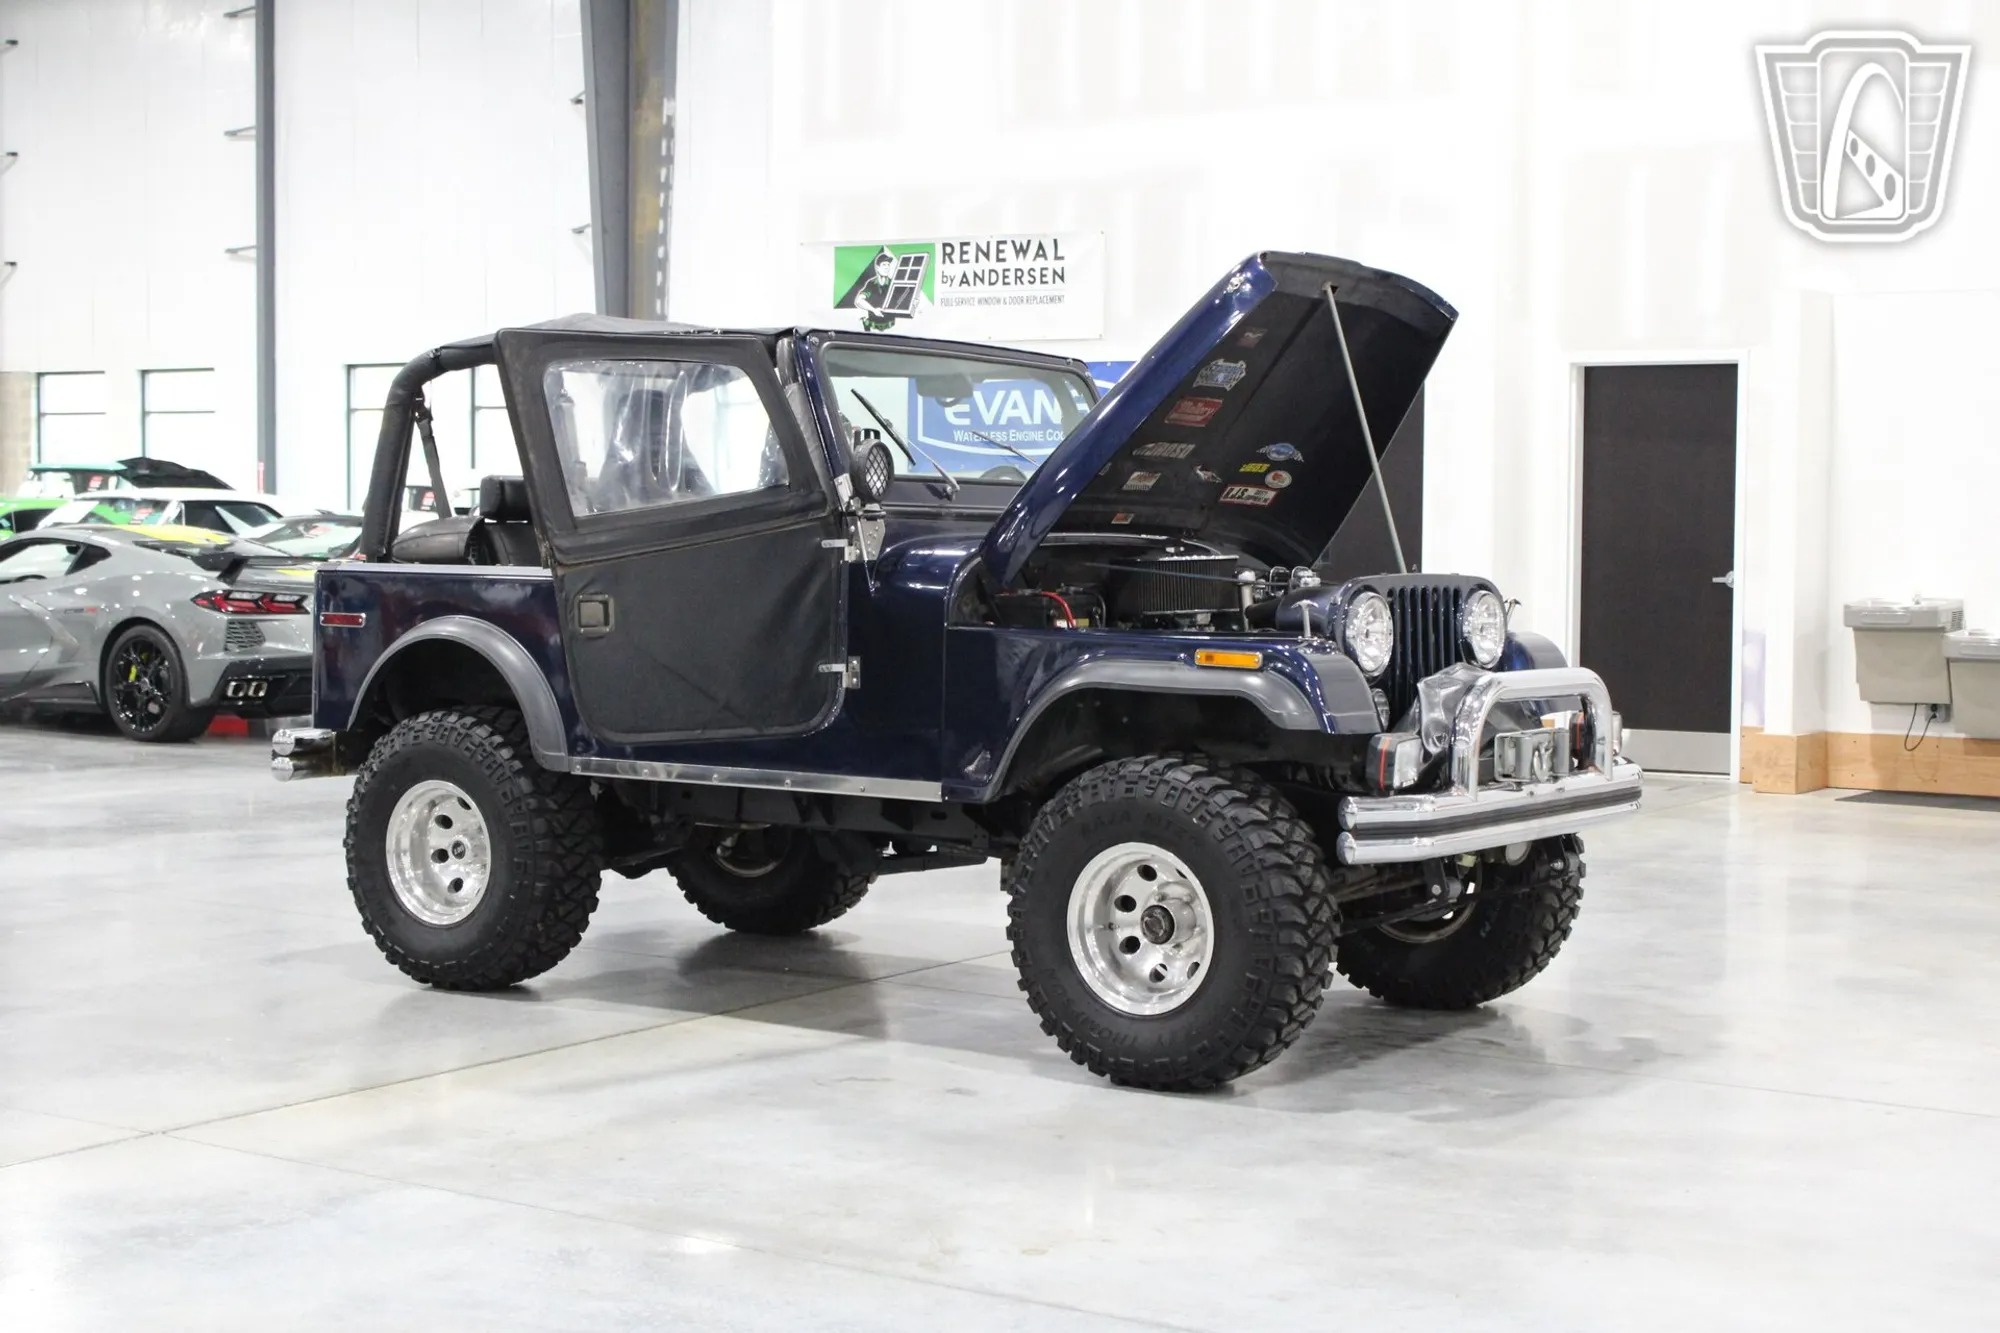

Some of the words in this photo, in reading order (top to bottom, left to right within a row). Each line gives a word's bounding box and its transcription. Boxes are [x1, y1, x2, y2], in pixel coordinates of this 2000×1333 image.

[942, 239, 1065, 264] RENEWAL
[941, 270, 956, 287] by
[959, 267, 1065, 287] ANDERSEN
[940, 297, 954, 307] FULL
[955, 297, 976, 307] SERVICE
[977, 296, 1001, 306] WINDOW
[1002, 297, 1007, 305] &
[1008, 295, 1025, 305] DOOR
[1026, 294, 1065, 304] REPLACEMENT
[944, 389, 1063, 426] EVAN
[1009, 429, 1044, 441] ENGINE
